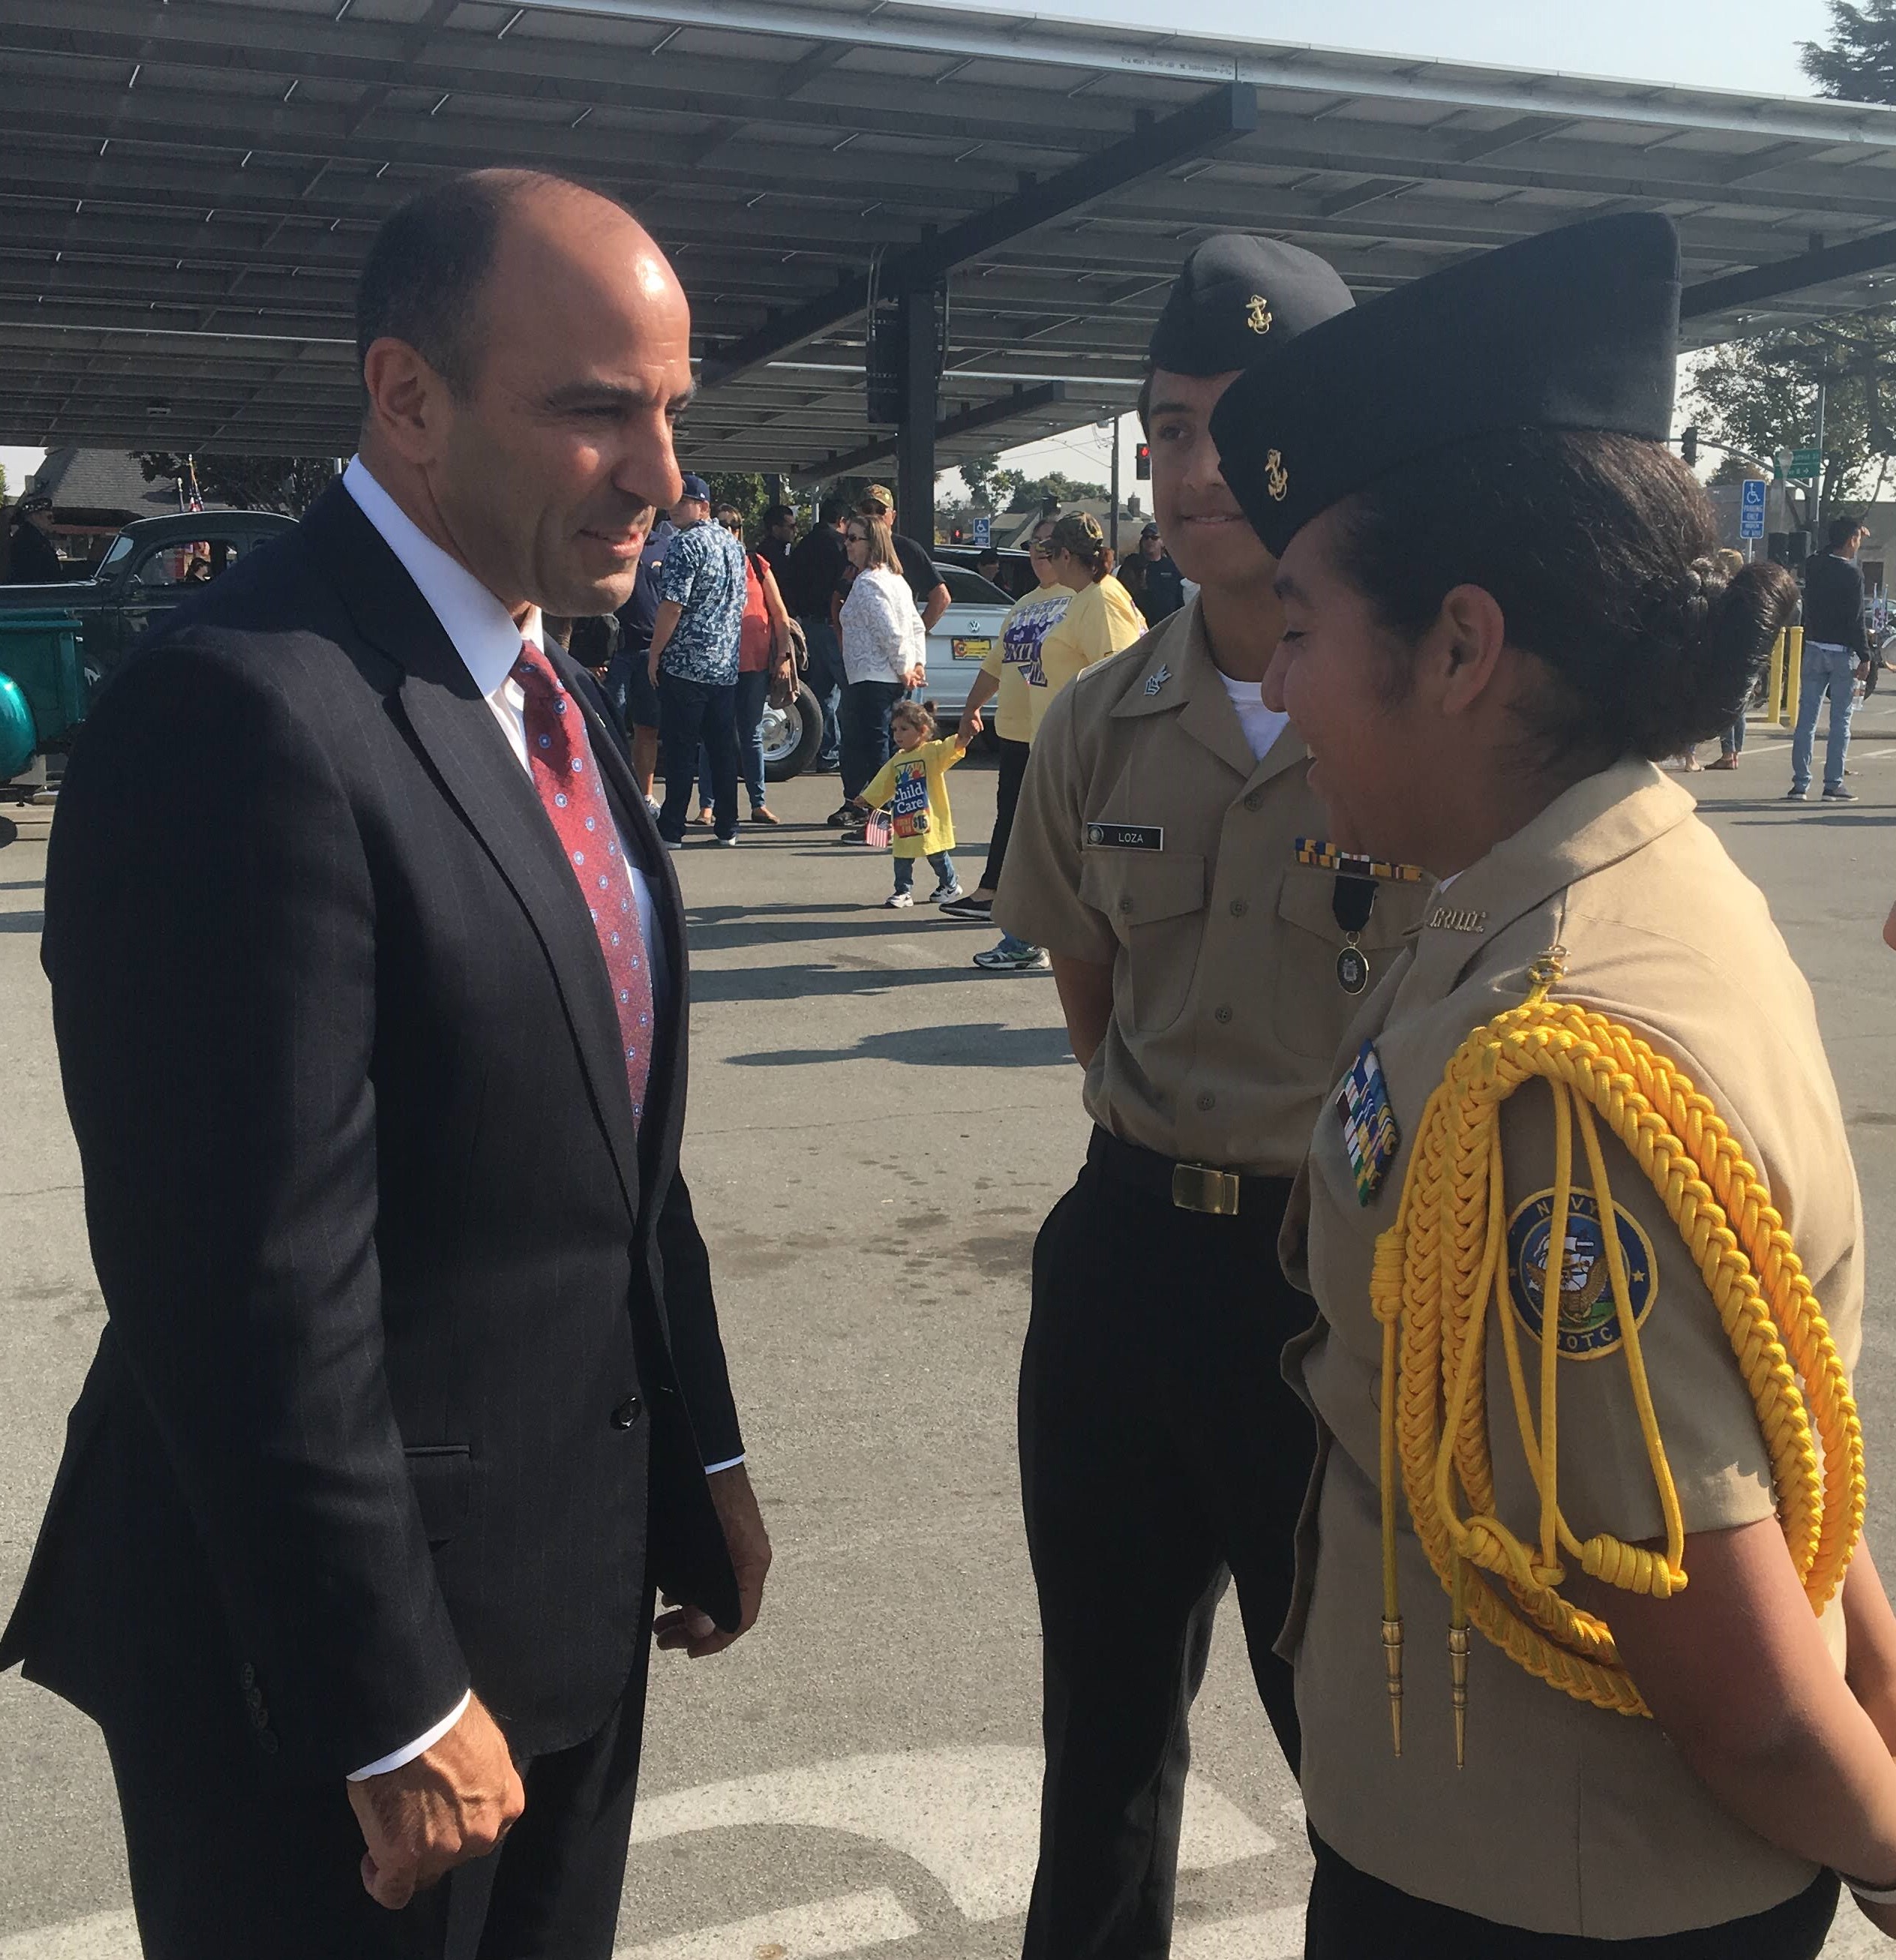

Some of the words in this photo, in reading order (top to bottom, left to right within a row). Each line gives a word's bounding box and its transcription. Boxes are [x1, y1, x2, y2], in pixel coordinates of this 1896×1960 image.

[896, 799, 924, 814] Care
[913, 815, 927, 830] $15
[1118, 833, 1144, 843] LOZA
[1537, 1196, 1600, 1217] NVY
